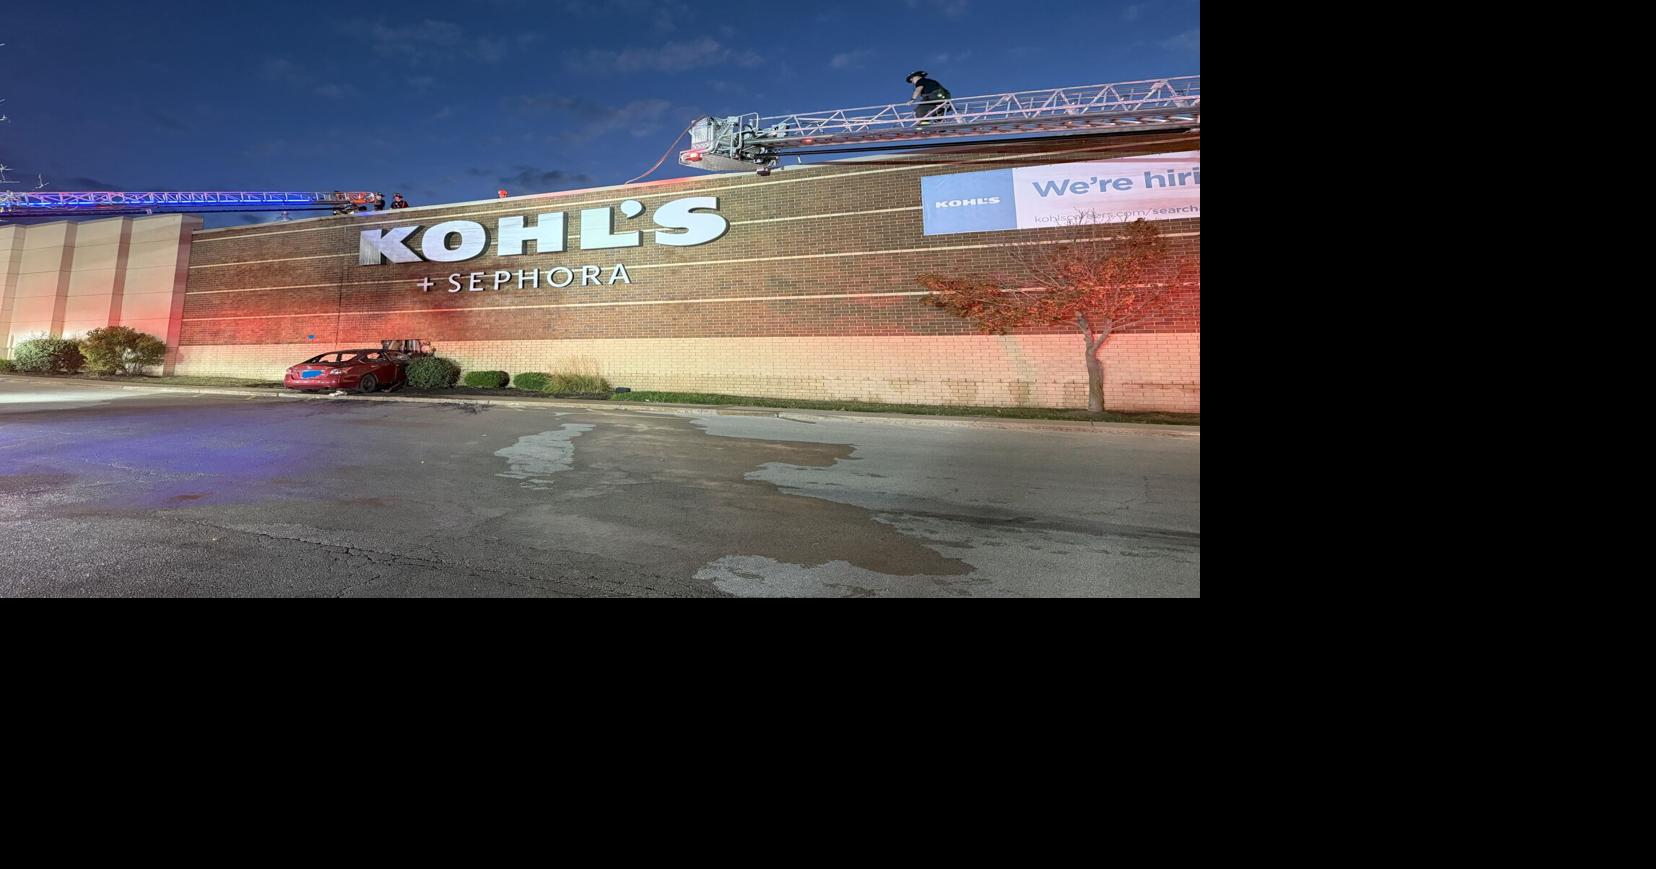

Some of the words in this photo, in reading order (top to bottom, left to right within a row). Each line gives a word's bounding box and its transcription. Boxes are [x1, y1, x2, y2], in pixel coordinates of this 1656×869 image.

[1032, 176, 1134, 198] We're
[1143, 167, 1200, 189] hiri
[935, 196, 1001, 209] KOHL'S
[359, 196, 729, 266] KOHL'S
[447, 263, 632, 293] SEPHORA
